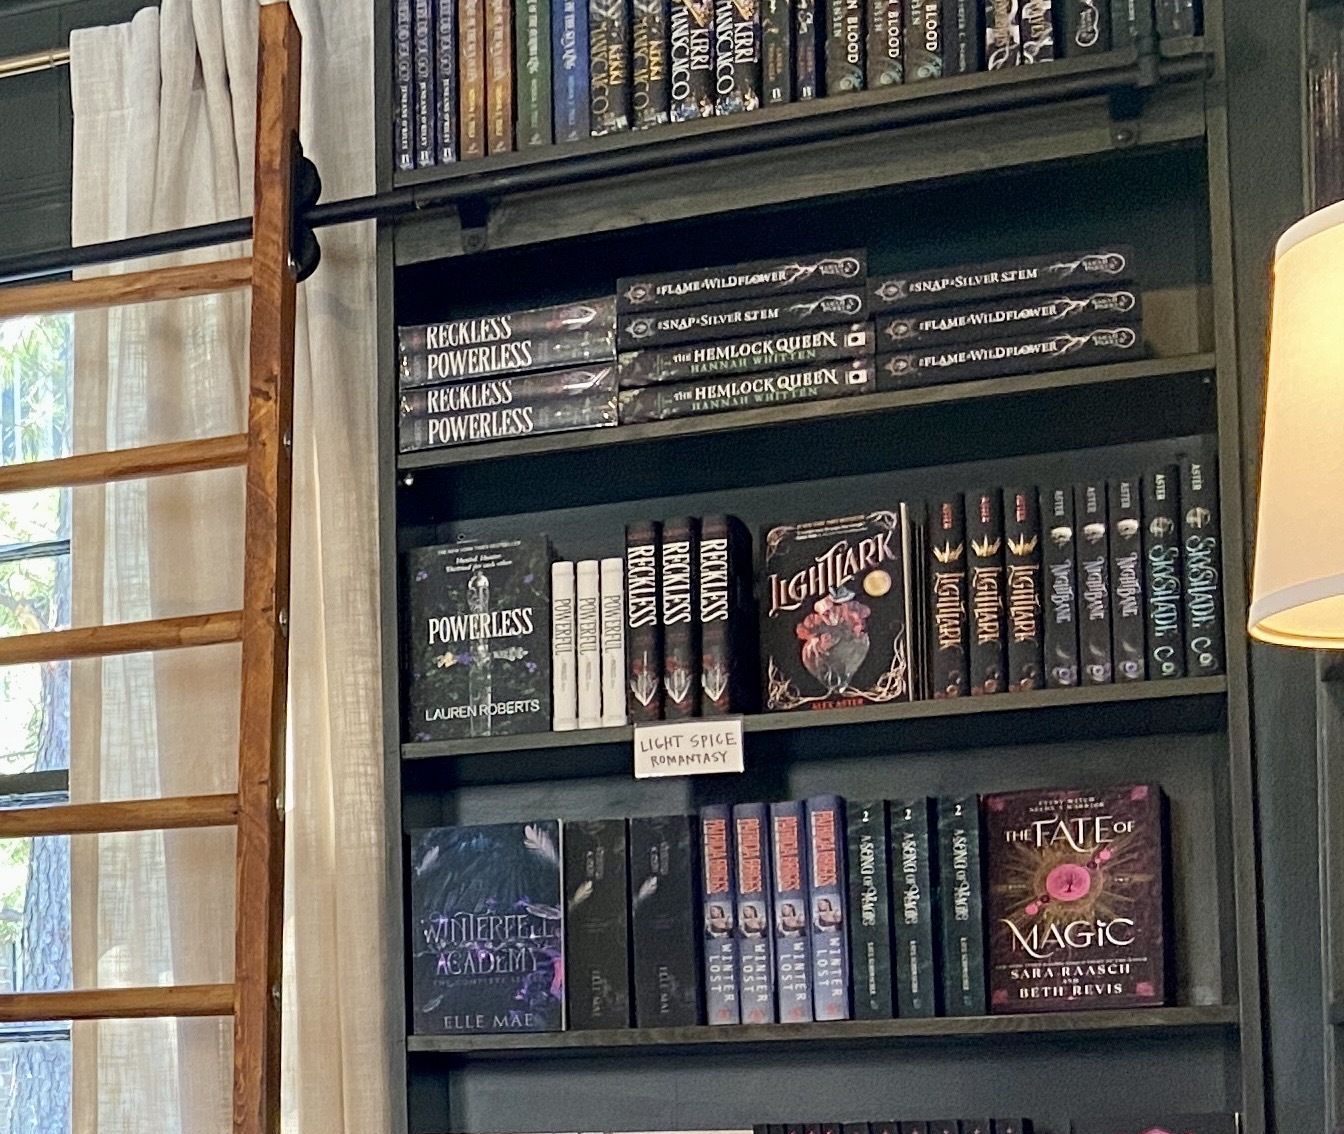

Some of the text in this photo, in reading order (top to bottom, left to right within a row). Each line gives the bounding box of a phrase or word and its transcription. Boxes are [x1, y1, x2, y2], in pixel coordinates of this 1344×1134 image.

[847, 17, 858, 64] BLOOD
[888, 11, 900, 58] BLOOD
[926, 5, 938, 52] BLOOD
[691, 29, 711, 70] KERRI
[426, 315, 512, 350] RECKLESS
[693, 341, 774, 363] HEMLOCK
[776, 331, 838, 353] QUEEN
[426, 342, 532, 379] POWERLESS
[427, 380, 512, 414] RECKLESS
[695, 378, 775, 400] HEMLOCK
[777, 369, 839, 391] QUEEN
[428, 407, 534, 444] POWERLESS
[627, 545, 657, 628] RECKLESS
[663, 541, 692, 626] RECKLESS
[768, 530, 898, 618] LIGHTLARK
[428, 608, 534, 644] POWERLESS
[554, 598, 572, 656] POWERFUL
[580, 597, 598, 656] POWERFUL
[425, 699, 540, 721] LAUREN ROBERTS
[640, 732, 738, 753] LIGHT SPICE
[650, 751, 729, 768] ROMANTASY
[1004, 814, 1135, 853] THE FATE OF
[421, 912, 557, 945] WINTERFELL
[1000, 918, 1136, 959] MAGIC
[436, 947, 538, 976] ACADEMY
[709, 956, 722, 994] LOST
[721, 943, 734, 1002] WINTER
[816, 950, 830, 987] LOST
[830, 938, 843, 997] WINTER
[1011, 963, 1130, 979] SARA RAASCH
[1020, 983, 1123, 999] BETH REVIS
[443, 1013, 535, 1030] ELLE MAE
